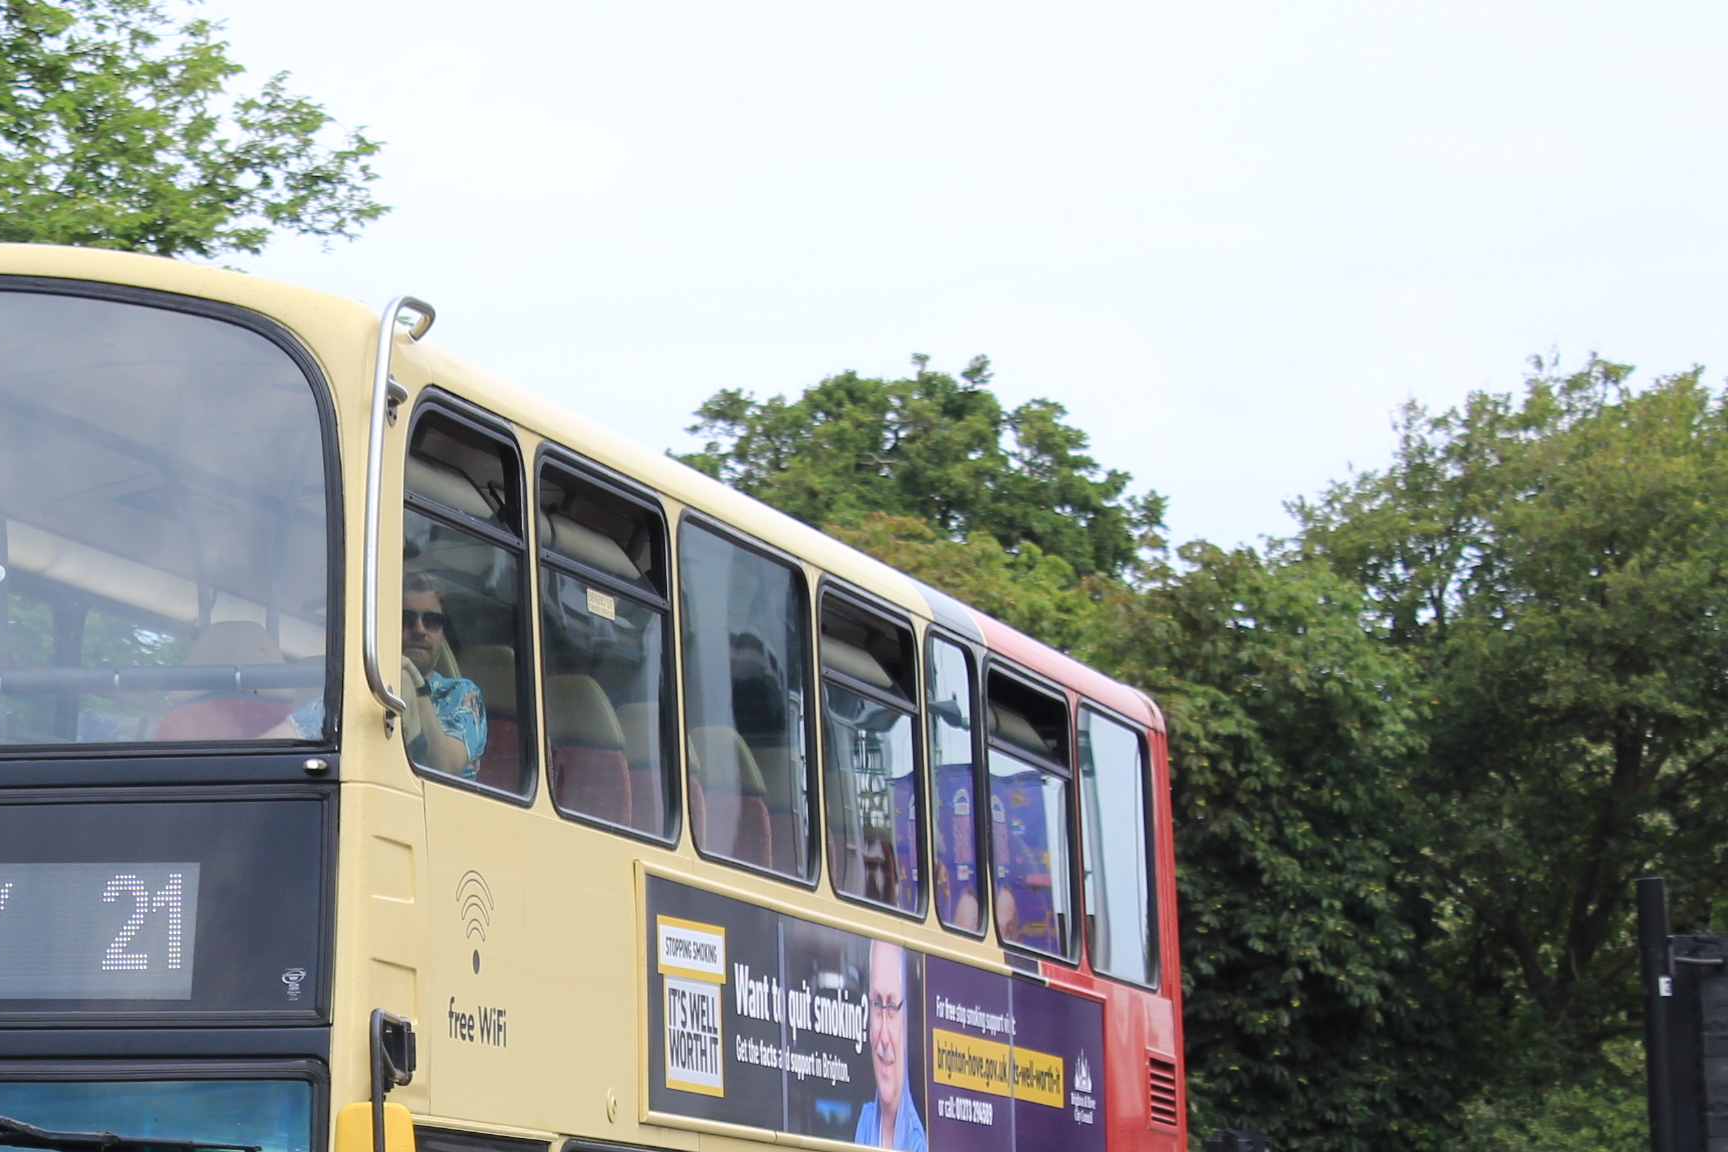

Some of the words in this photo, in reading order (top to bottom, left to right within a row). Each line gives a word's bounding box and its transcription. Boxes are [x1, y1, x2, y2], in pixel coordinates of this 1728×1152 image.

[99, 872, 184, 972] 21
[665, 935, 692, 960] STOPPING
[692, 940, 717, 964] SMOKING
[447, 996, 474, 1041] free
[477, 1005, 507, 1047] WiFi
[668, 986, 687, 1029] IT'S
[688, 991, 717, 1035] WELL
[734, 962, 770, 1022] Want
[771, 977, 785, 1024] to
[788, 979, 812, 1042] quit
[813, 987, 869, 1055] smoking?
[936, 995, 945, 1018] For
[945, 997, 956, 1021] free
[956, 1003, 967, 1028] stop
[966, 1004, 985, 1033] smoking
[985, 1013, 1003, 1036] support
[668, 1026, 708, 1072] WORTH
[709, 1036, 719, 1075] IT
[735, 1033, 747, 1062] Get
[748, 1036, 760, 1064] the
[760, 1038, 777, 1068] facts
[778, 1045, 790, 1071] ad
[790, 1051, 814, 1080] support
[815, 1050, 823, 1077] in
[937, 1099, 945, 1116] or
[956, 1098, 971, 1121] 01273
